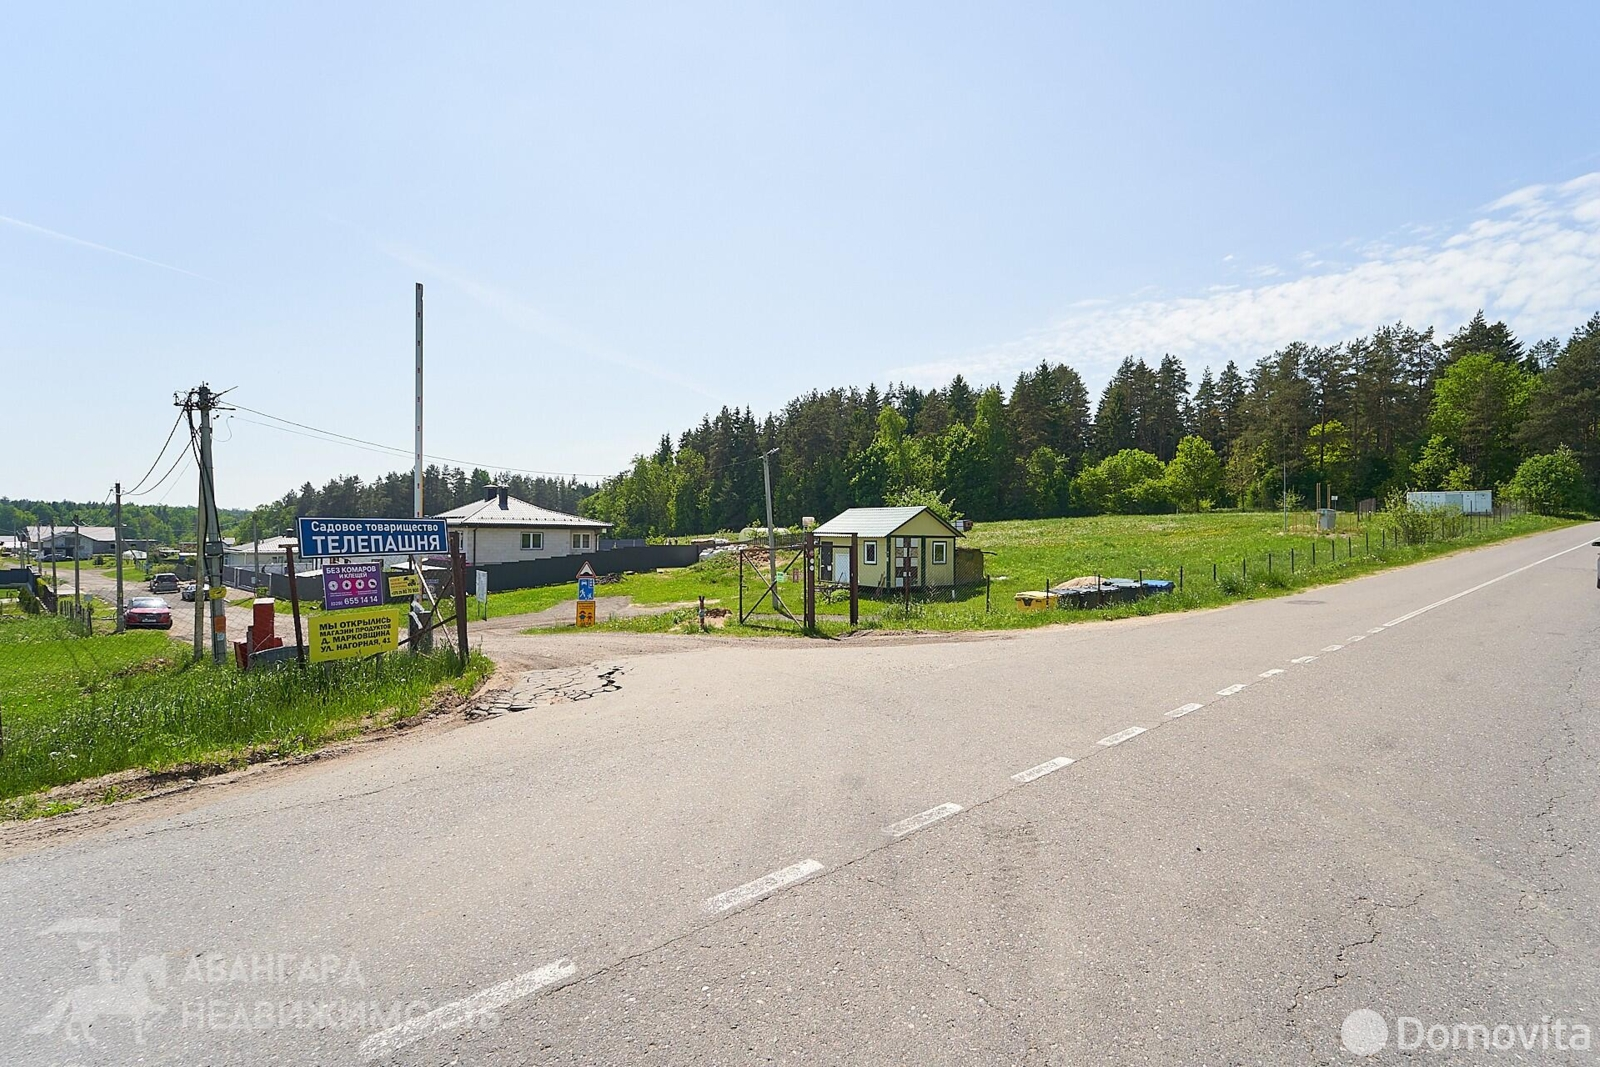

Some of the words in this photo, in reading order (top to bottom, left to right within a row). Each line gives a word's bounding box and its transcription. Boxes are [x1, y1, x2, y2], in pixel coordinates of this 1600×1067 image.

[311, 520, 362, 533] Садовое
[365, 521, 439, 534] товарищество
[312, 535, 440, 554] ТЕЛЕПАШНЯ
[319, 623, 337, 631] МЫ
[339, 616, 391, 628] ОТКРЫЛИСЬ
[320, 629, 354, 637] МАГАЗИН
[355, 624, 391, 633] ПРОДУКТОВ
[332, 630, 390, 643] МАРКОВЩИНА
[336, 640, 381, 651] НАГОРНАЯ,
